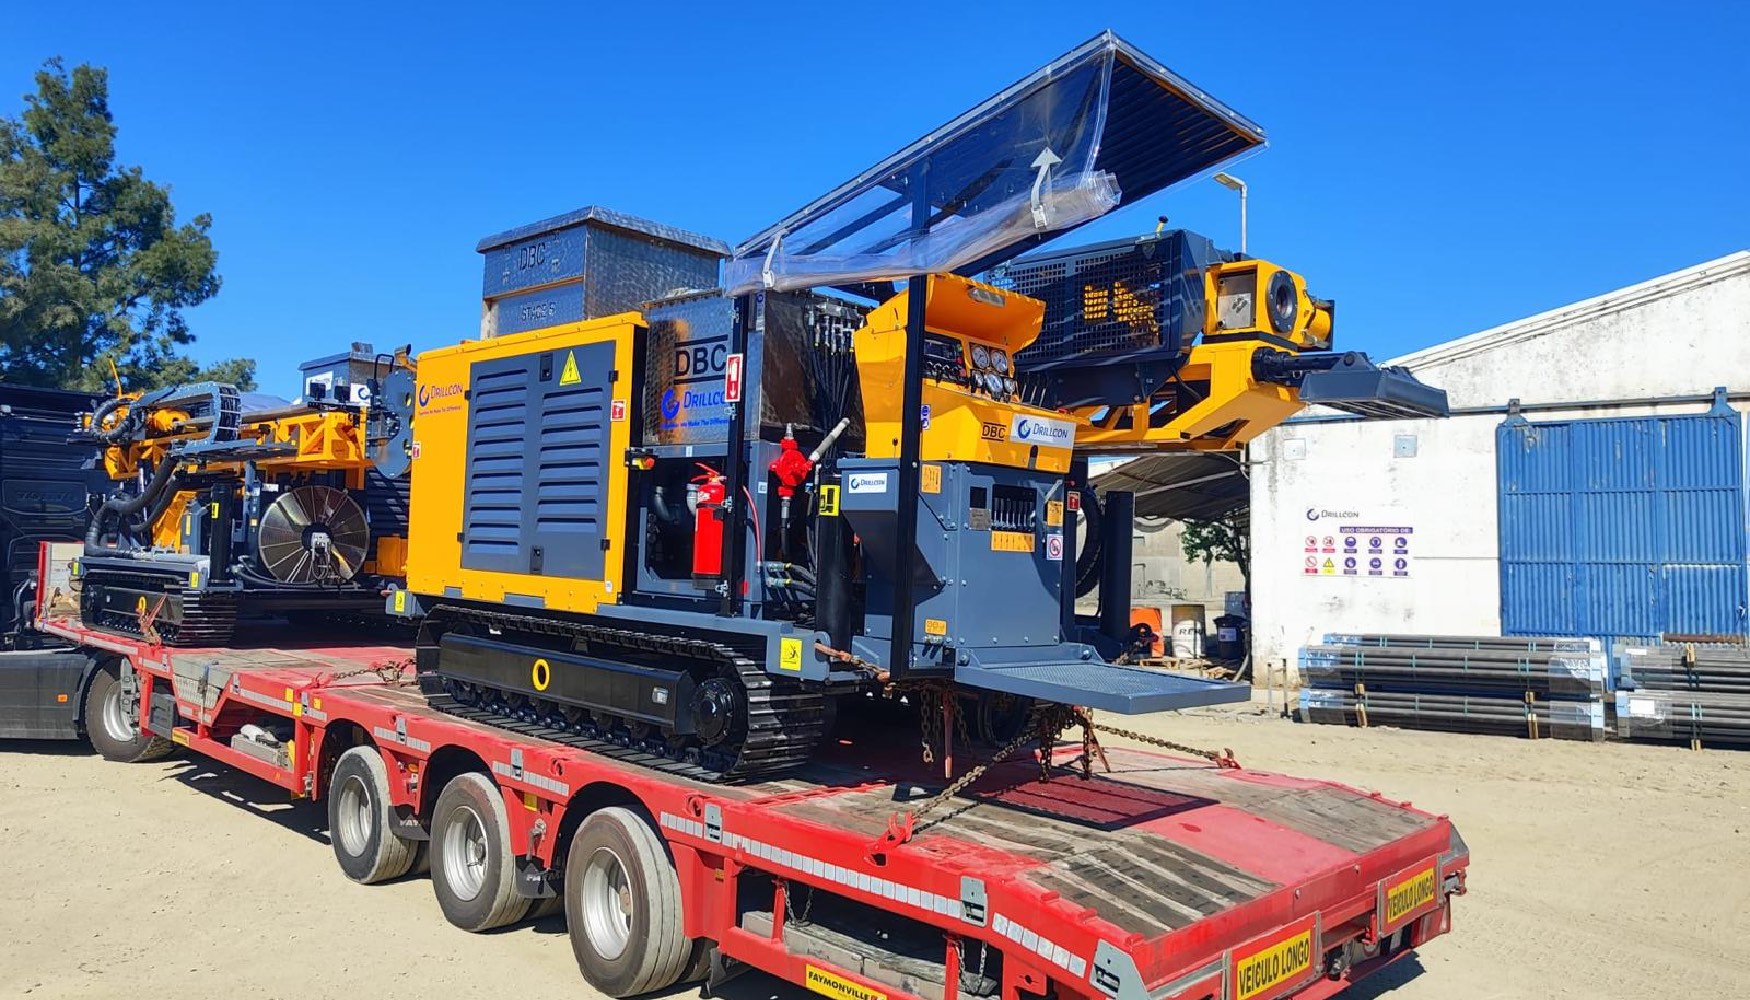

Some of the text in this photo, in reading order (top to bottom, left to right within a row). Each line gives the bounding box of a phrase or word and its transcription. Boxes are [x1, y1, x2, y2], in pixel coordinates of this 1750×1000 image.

[520, 242, 546, 270] DBC
[675, 344, 727, 376] DBC
[684, 391, 726, 408] DRILLCO
[982, 425, 1006, 438] DBC
[1033, 423, 1068, 438] DRILLCON
[1388, 876, 1434, 918] VEÍCULO LONGO
[1239, 937, 1310, 996] VEÍCULO LONGO
[808, 971, 871, 1000] FAYMONVILLE
